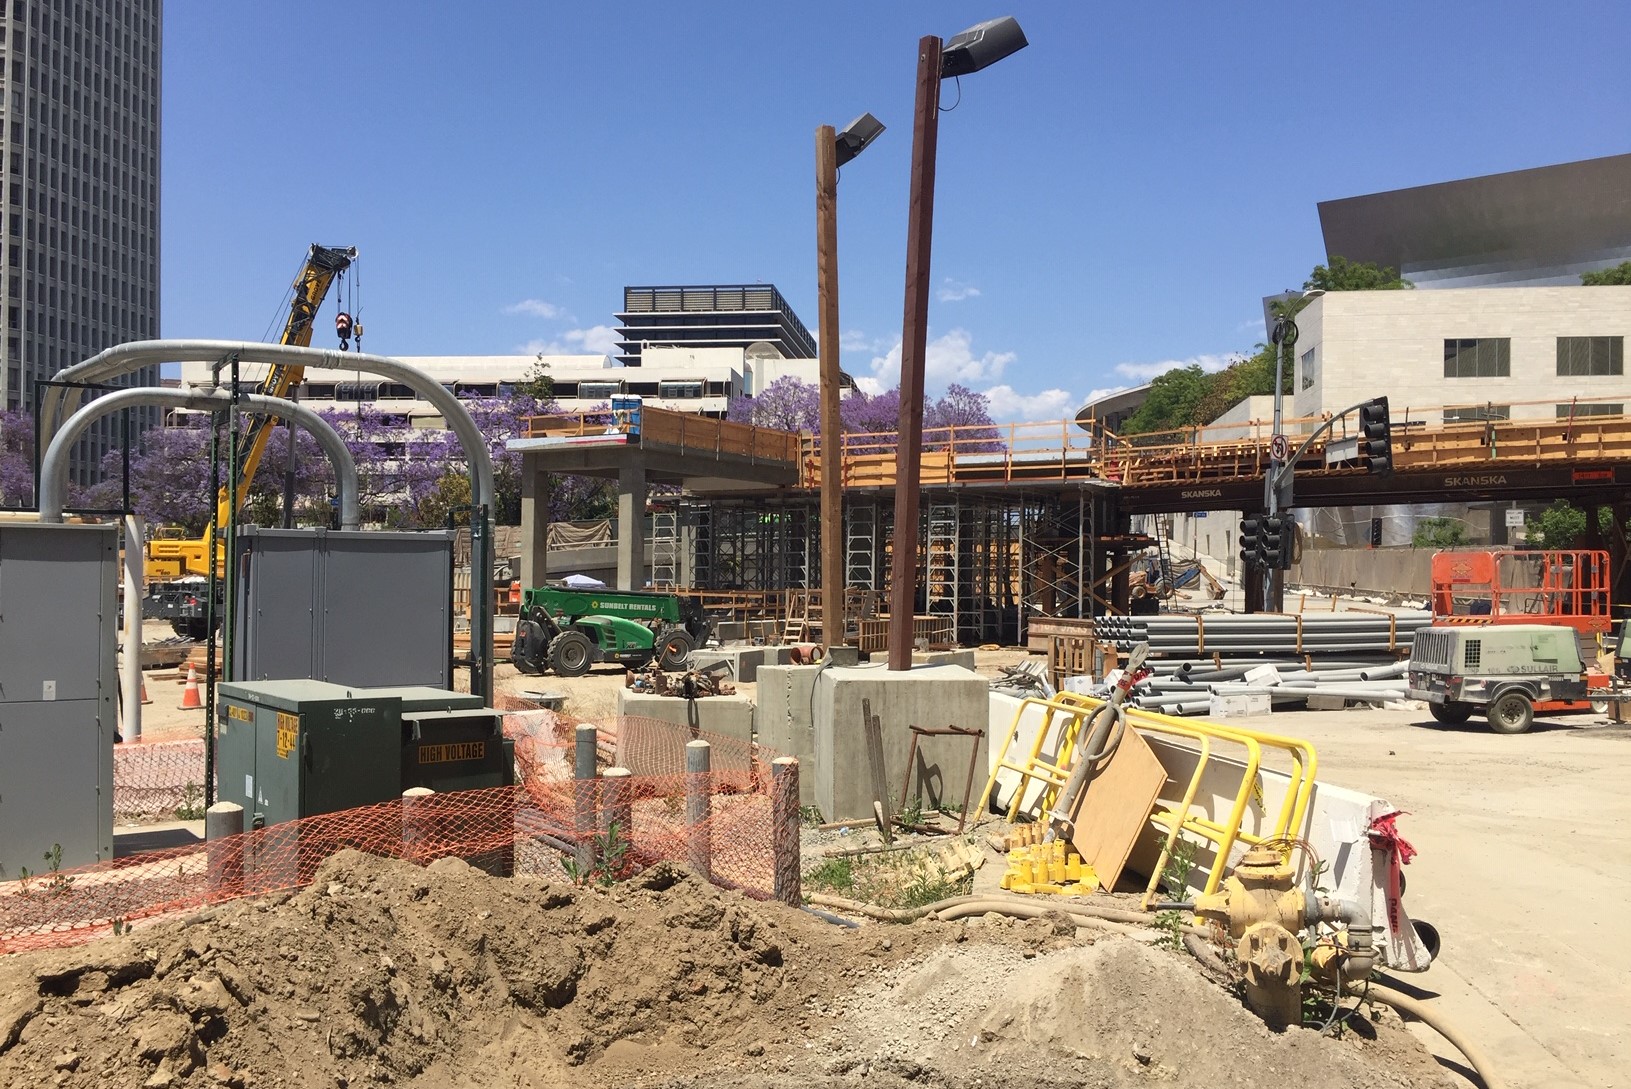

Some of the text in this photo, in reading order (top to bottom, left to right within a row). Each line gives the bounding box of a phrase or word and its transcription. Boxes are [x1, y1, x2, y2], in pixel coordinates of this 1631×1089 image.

[1444, 475, 1508, 487] SKANSKA
[1181, 489, 1222, 499] SKANSKA
[600, 602, 657, 611] SUNBELT RENTALS
[1521, 665, 1558, 673] SULLAIR
[420, 742, 483, 762] HIGH VOLTAGE
